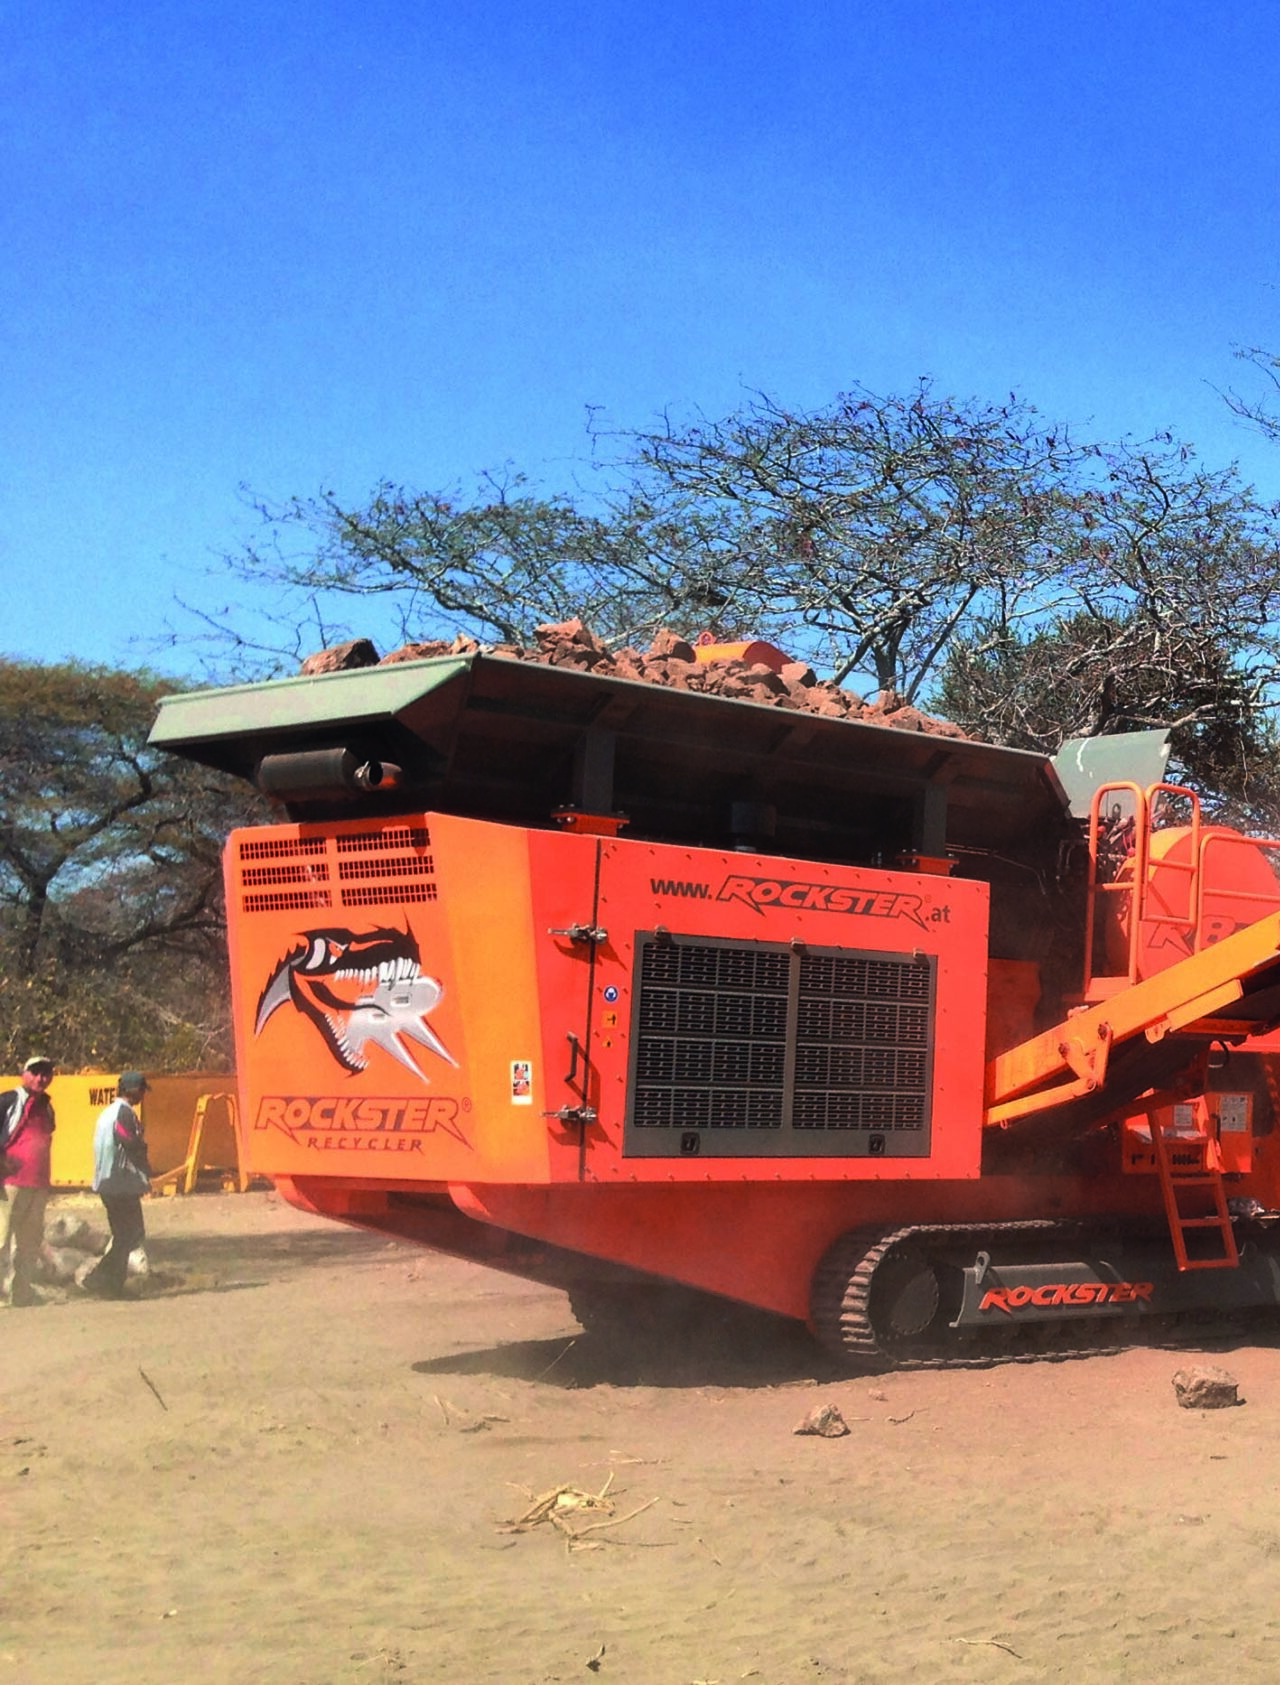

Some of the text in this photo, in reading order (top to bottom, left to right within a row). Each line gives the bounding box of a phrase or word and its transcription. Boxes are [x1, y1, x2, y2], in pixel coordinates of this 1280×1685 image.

[89, 1087, 117, 1106] WATE
[307, 1136, 426, 1155] RECYCLER
[978, 1282, 1154, 1314] ROCKSTER
